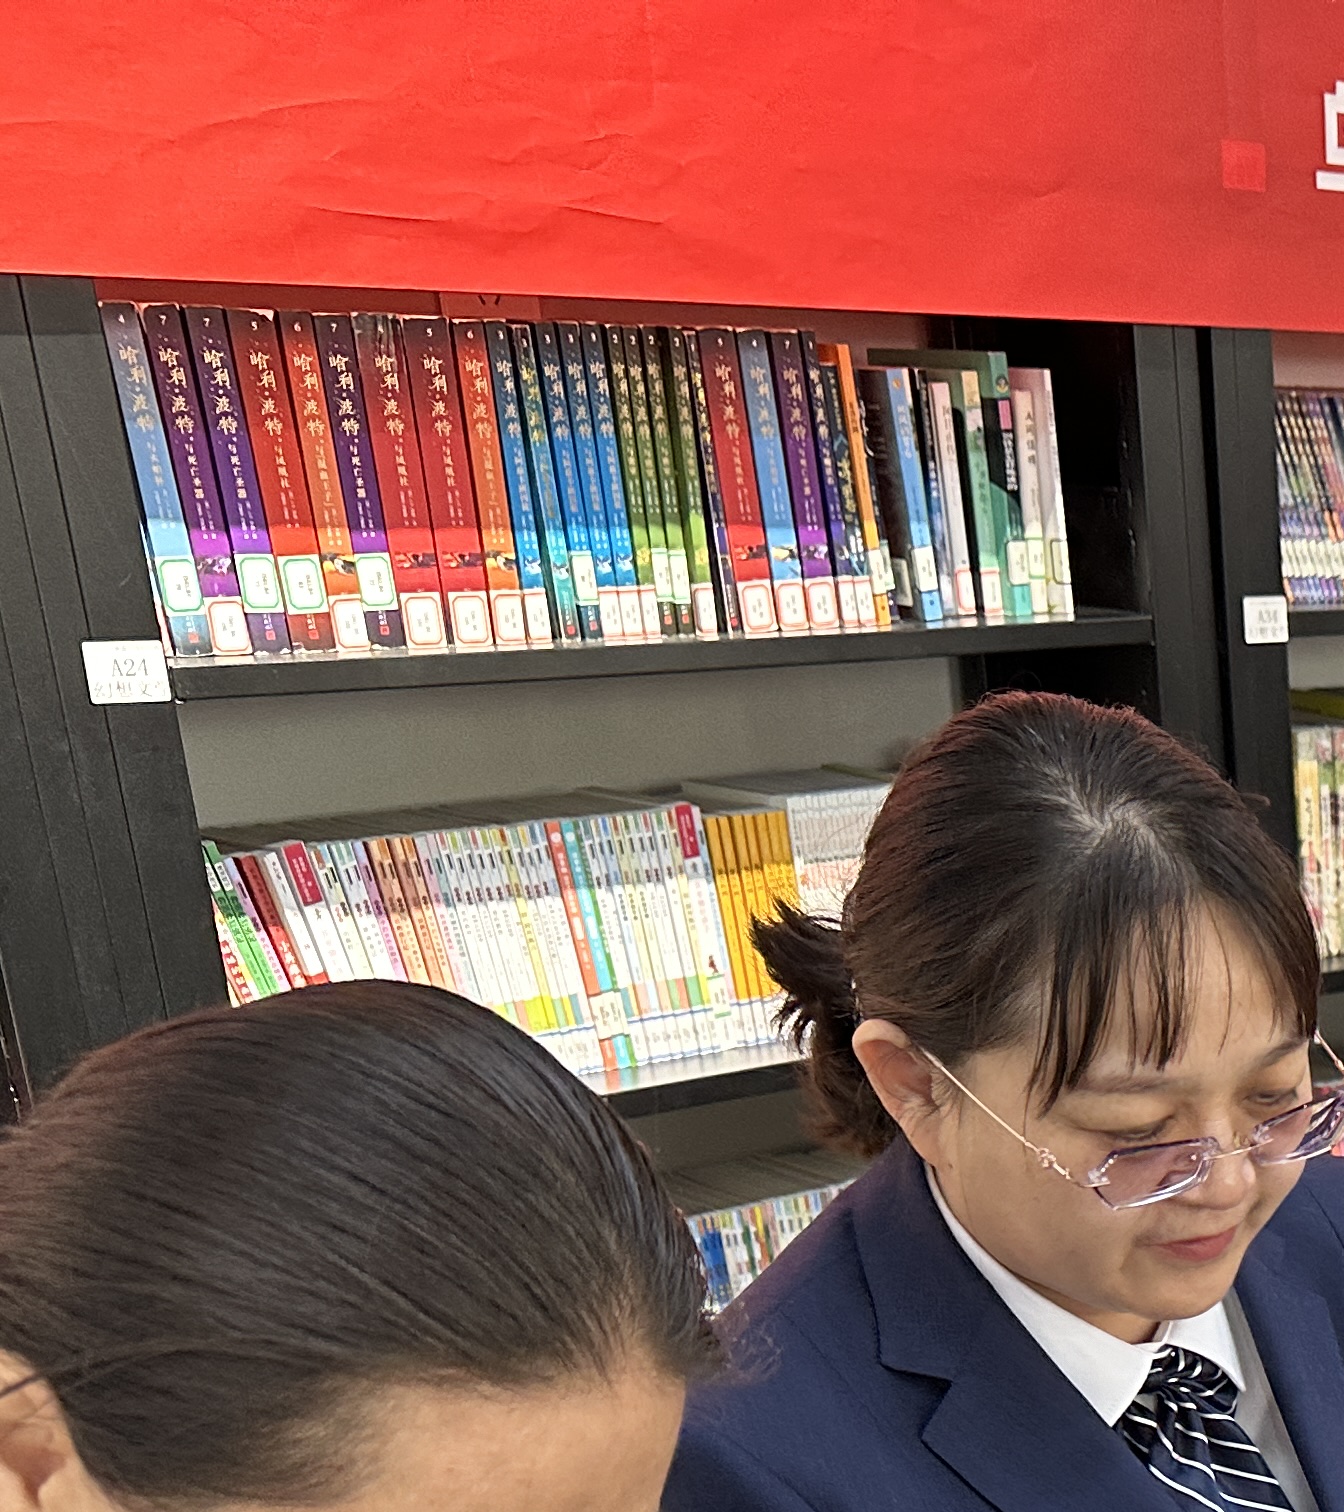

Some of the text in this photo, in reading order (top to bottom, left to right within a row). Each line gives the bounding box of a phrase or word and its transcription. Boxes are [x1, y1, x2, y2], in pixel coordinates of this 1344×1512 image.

[158, 347, 194, 435] 哈利·波特
[202, 348, 239, 435] 哈利·波特
[249, 351, 284, 436] 哈利·波特
[293, 353, 326, 437] 哈利·波特
[329, 354, 360, 437] 哈利·波特
[423, 356, 453, 437] 哈利·波特
[466, 358, 492, 439] 哈利·波特
